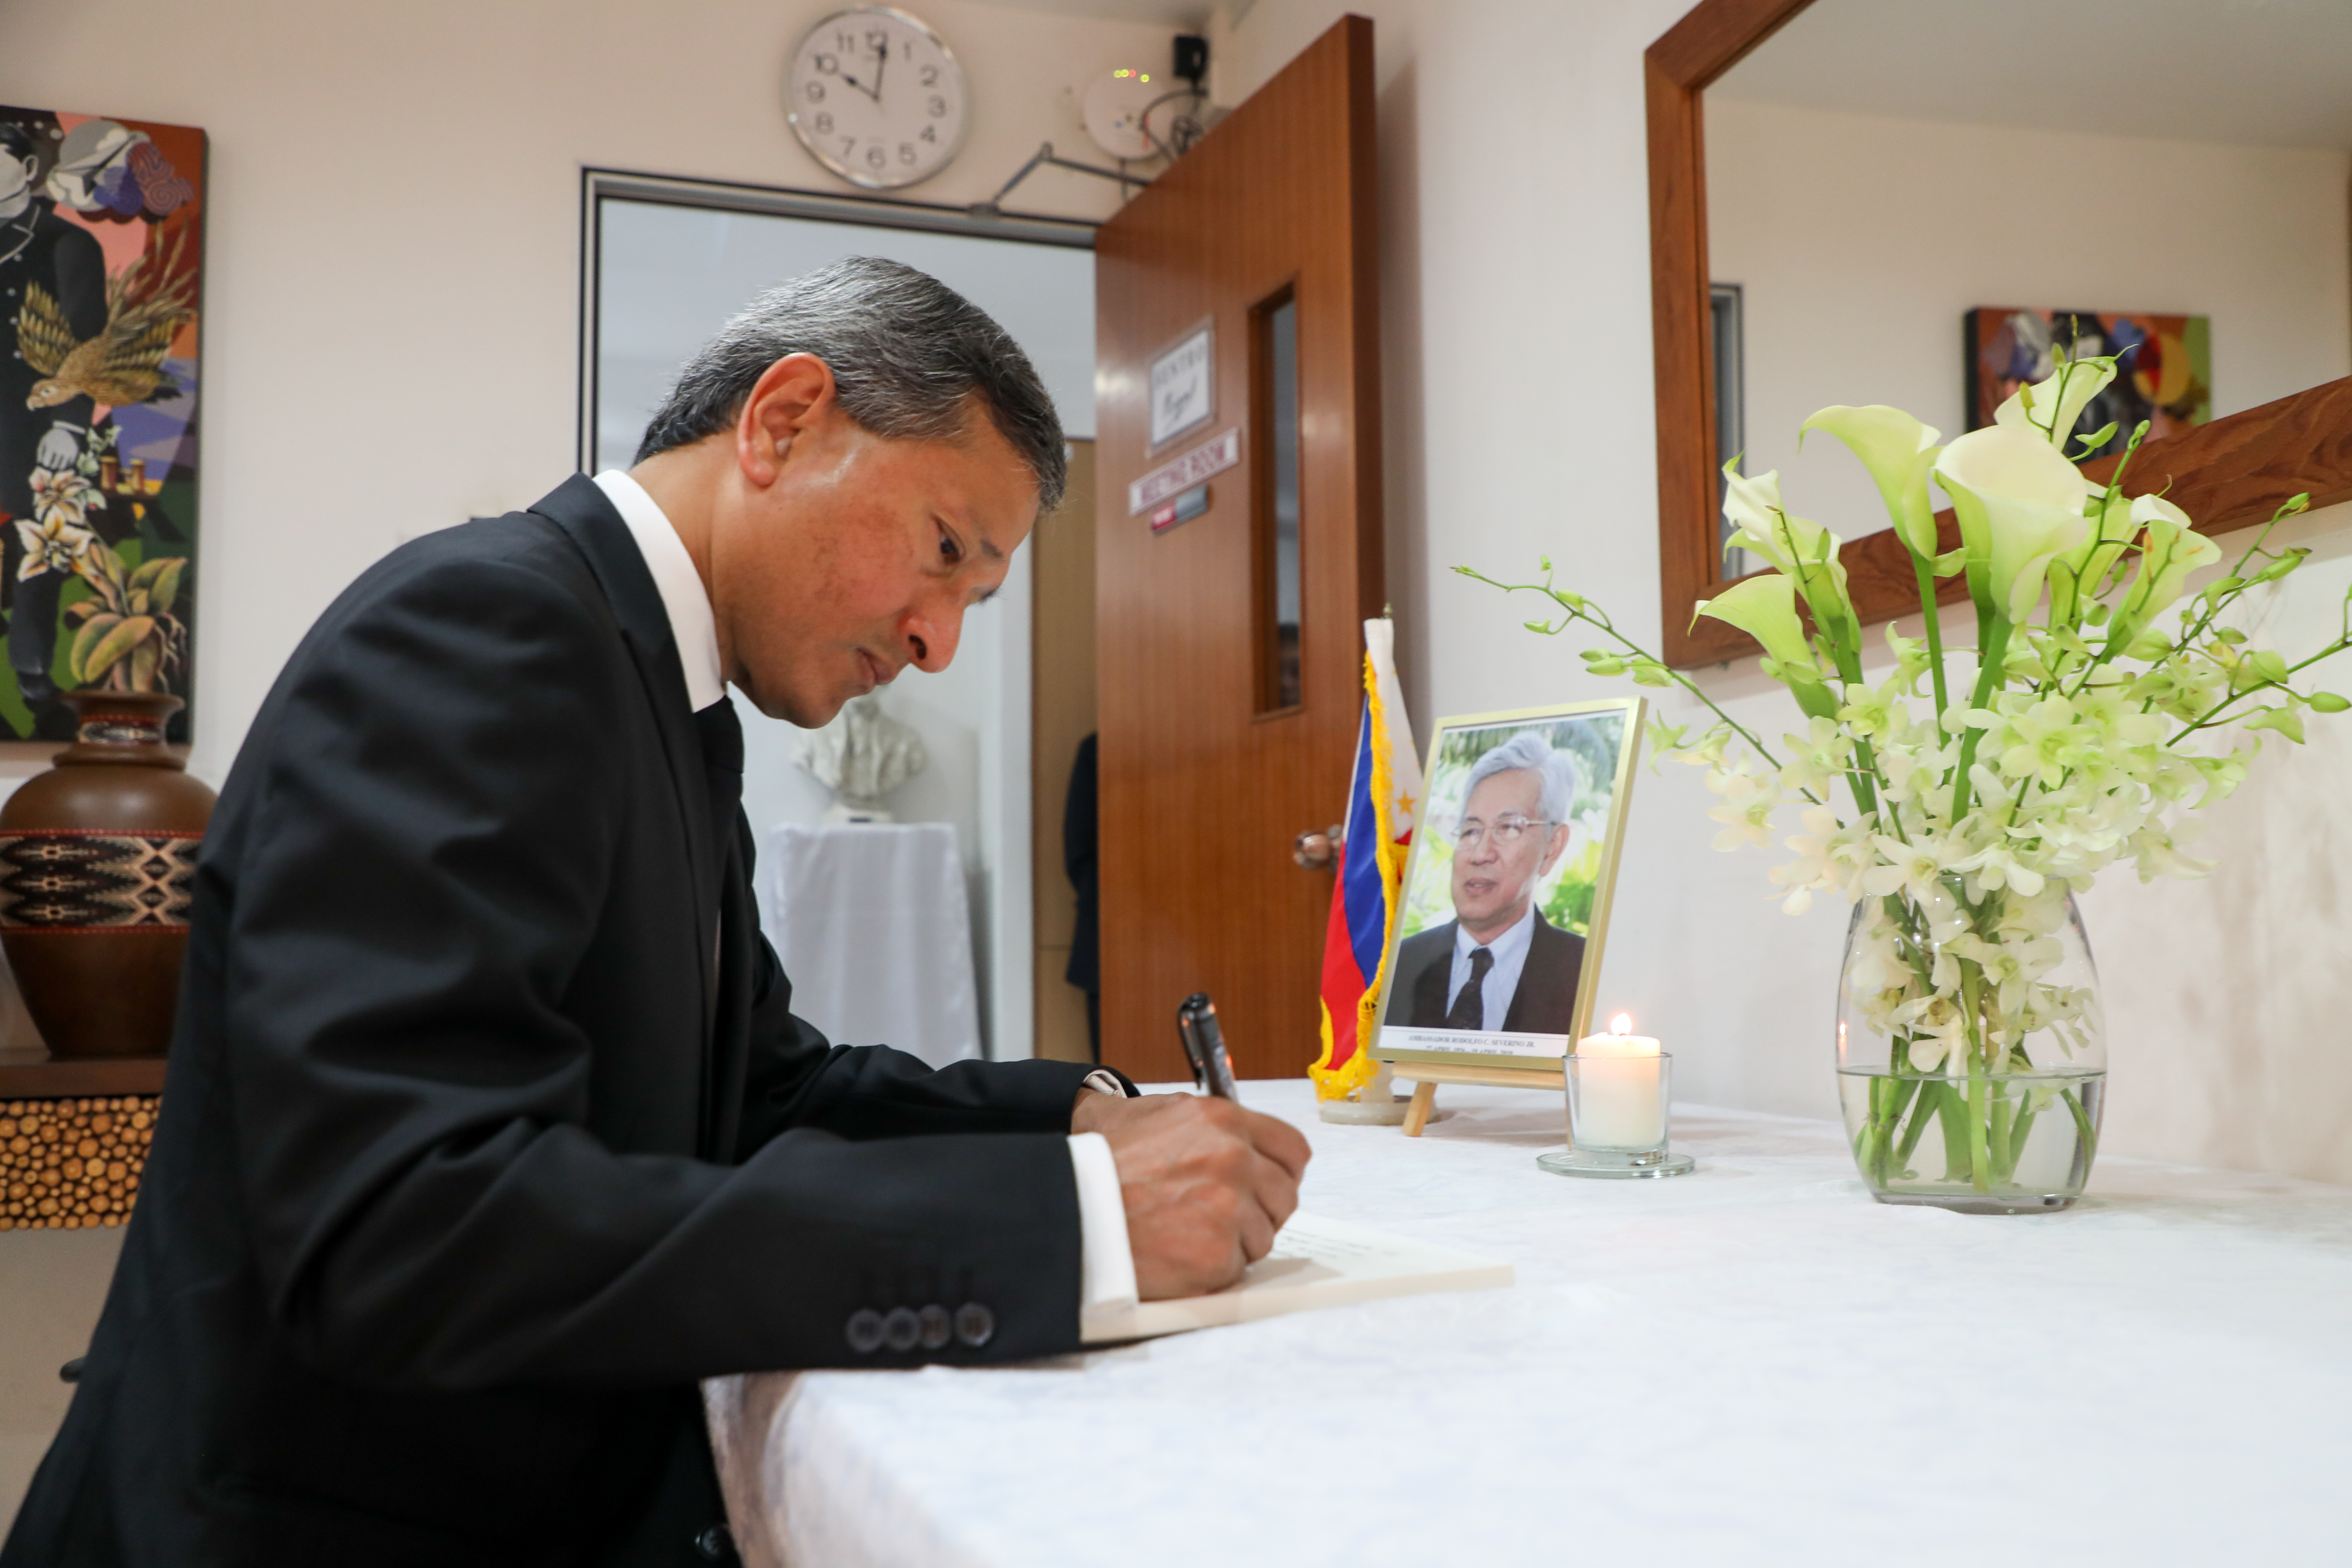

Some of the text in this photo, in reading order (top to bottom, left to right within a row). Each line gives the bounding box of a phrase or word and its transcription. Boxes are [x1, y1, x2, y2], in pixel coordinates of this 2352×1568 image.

[836, 31, 855, 54] 11
[903, 40, 912, 62] 1
[813, 53, 839, 76] 10
[920, 64, 939, 88] 2
[806, 80, 826, 105] 9
[928, 94, 947, 118] 3
[815, 111, 834, 135] 8
[920, 124, 936, 143] 4
[840, 135, 857, 158] 7
[866, 146, 887, 169] 6
[898, 141, 917, 166] 5
